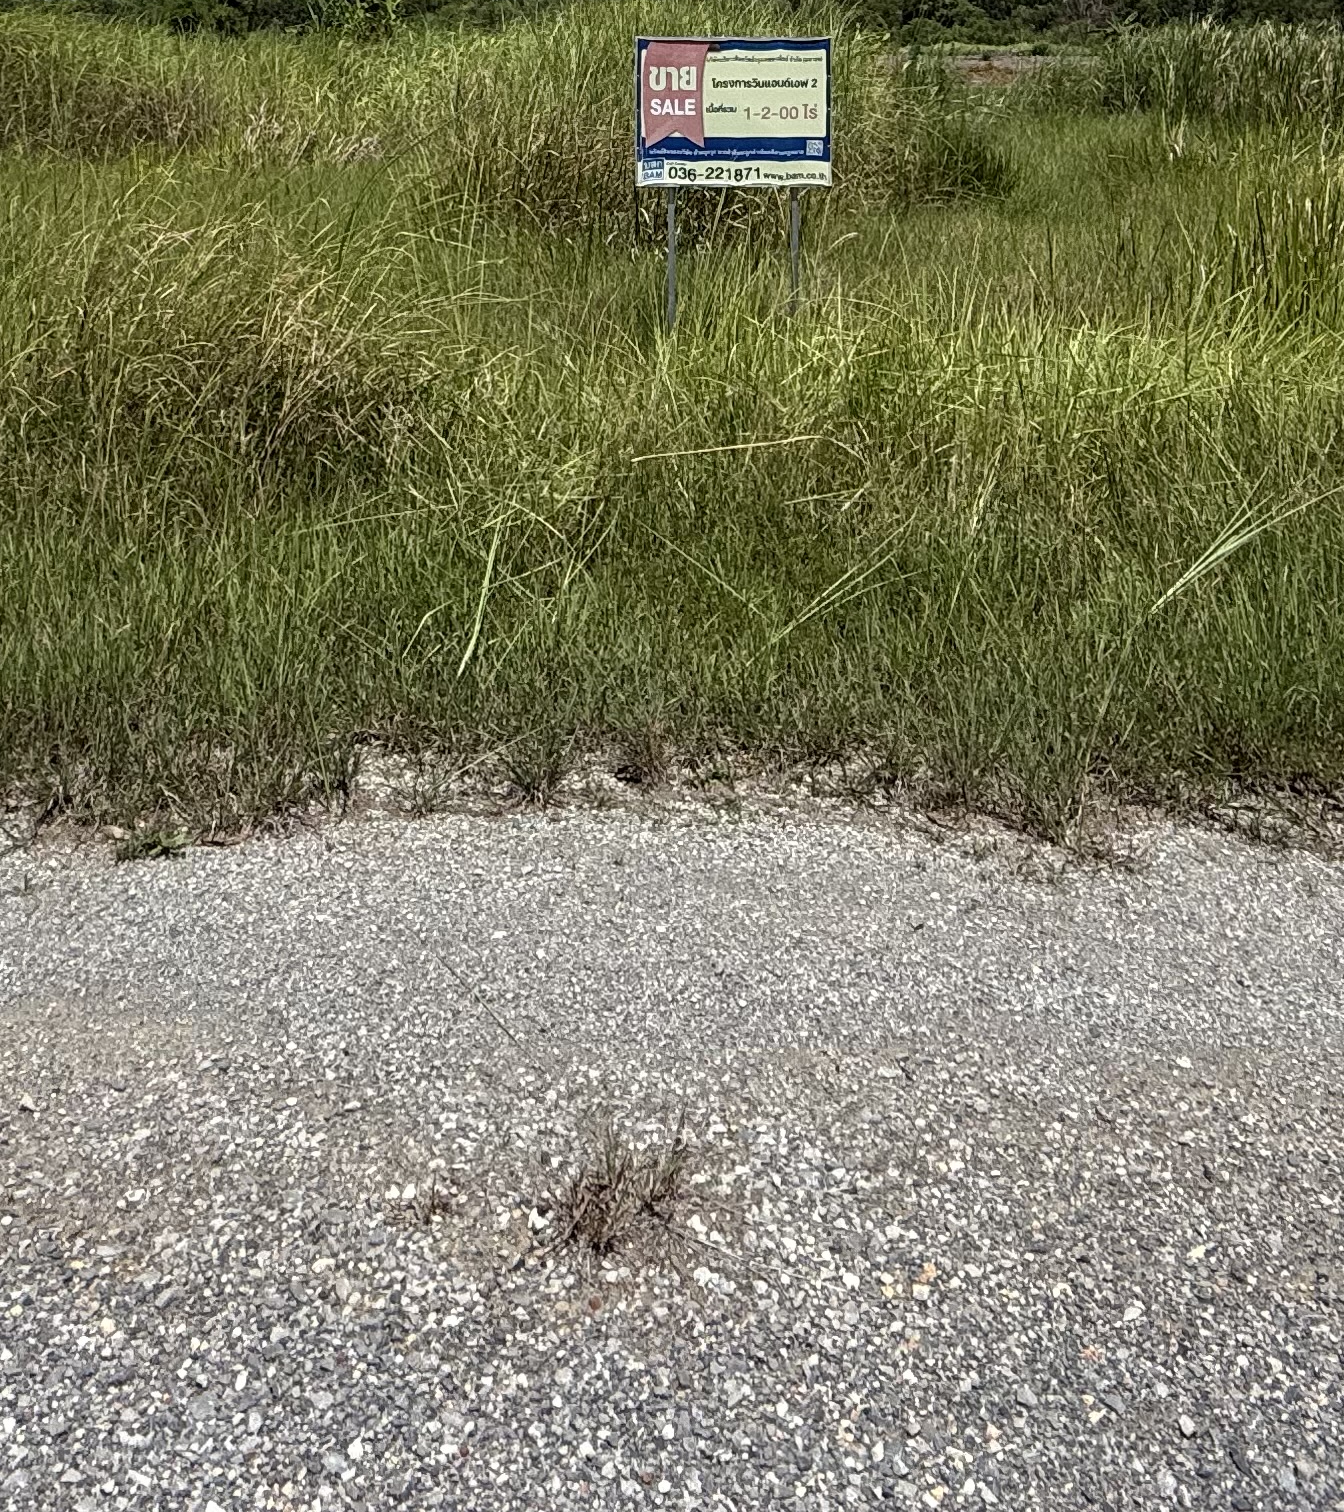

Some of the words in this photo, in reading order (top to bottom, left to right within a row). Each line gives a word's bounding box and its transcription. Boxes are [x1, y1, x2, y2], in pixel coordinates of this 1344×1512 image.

[649, 66, 697, 92] ขาย
[811, 78, 818, 89] 2
[650, 98, 697, 117] SALE
[743, 105, 799, 121] 1-2-00
[802, 103, 819, 120] ไร่
[642, 171, 663, 180] BAM
[668, 166, 761, 182] 036-221871
